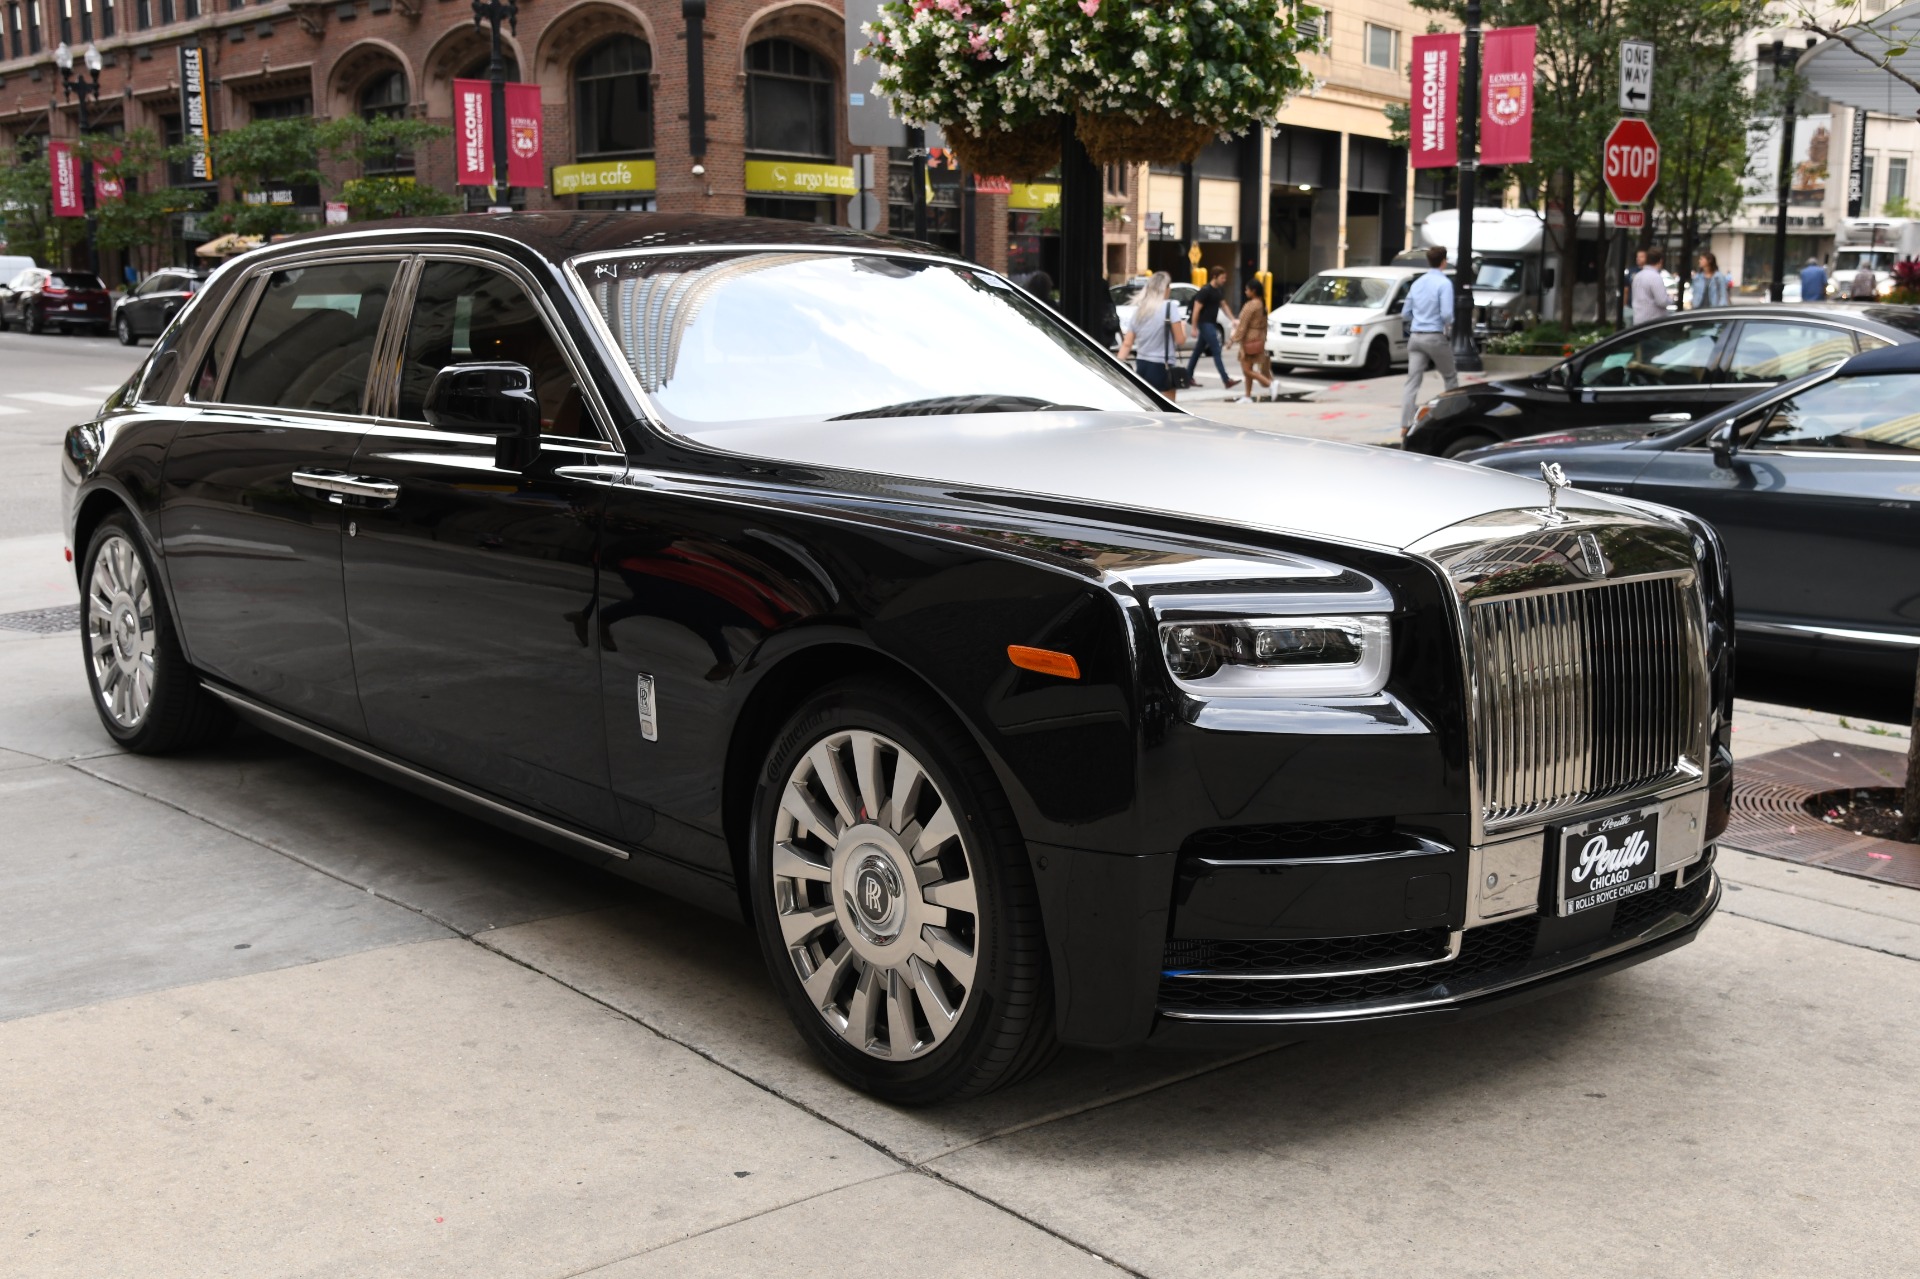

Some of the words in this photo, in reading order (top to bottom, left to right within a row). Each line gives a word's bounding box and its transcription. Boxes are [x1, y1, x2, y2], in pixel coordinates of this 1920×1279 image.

[185, 49, 201, 93] BAGELS
[1438, 50, 1447, 89] CAMPUS
[1625, 48, 1649, 65] ONE
[1489, 72, 1528, 84] LOYOLA
[1624, 67, 1649, 84] WAY
[1423, 50, 1438, 152] WELCOME
[1437, 90, 1446, 120] TOWER
[464, 93, 478, 173] WELCOME
[1437, 121, 1445, 151] WATER
[600, 162, 632, 185] café
[1607, 145, 1656, 178] STOP
[57, 151, 70, 207] WELCOME
[794, 172, 822, 191] argo
[1616, 214, 1627, 224] ALL
[1571, 829, 1650, 883] Perillo
[865, 876, 882, 913] RR
[1590, 868, 1630, 891] CHICAGO
[1575, 896, 1595, 911] ROLLS
[1596, 888, 1618, 904] ROYCE
[1618, 880, 1647, 899] CHICAGO
